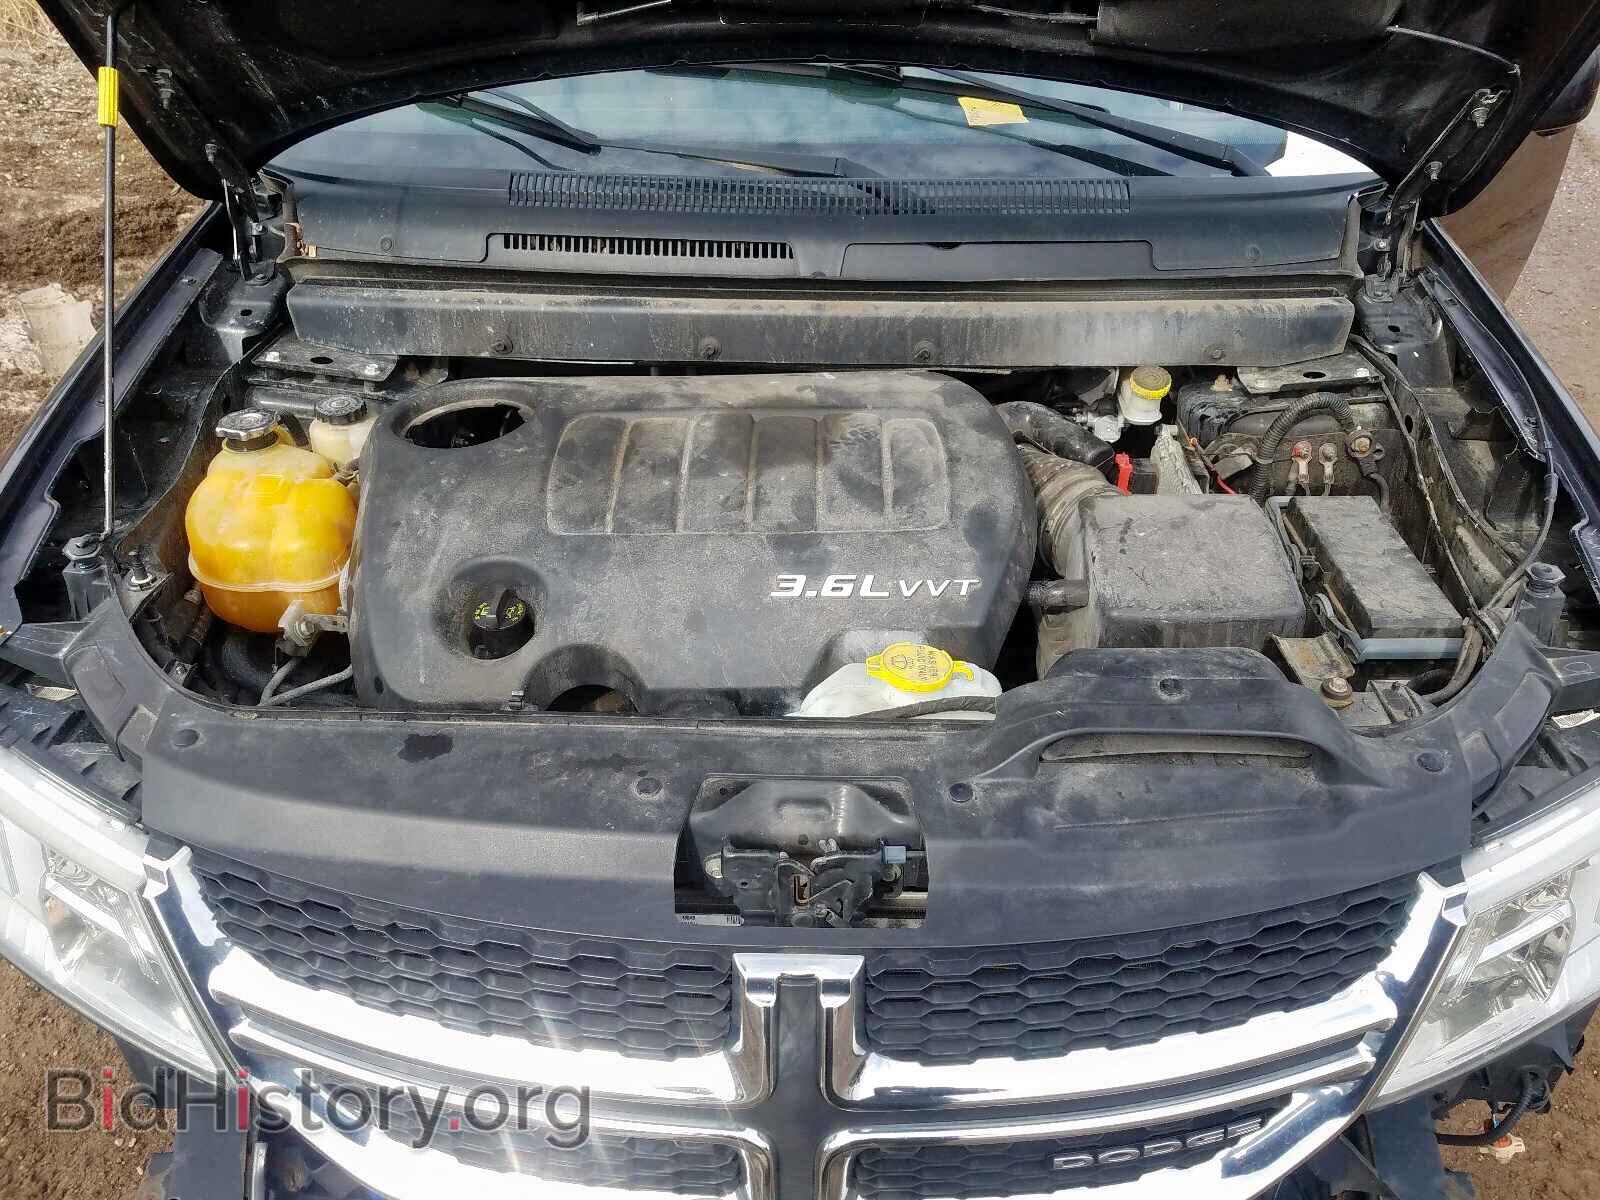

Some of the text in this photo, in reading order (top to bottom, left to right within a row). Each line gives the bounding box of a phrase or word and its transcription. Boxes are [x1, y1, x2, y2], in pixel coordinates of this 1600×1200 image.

[771, 574, 979, 598] 3.6L VVT
[1053, 1117, 1264, 1170] DODGE
